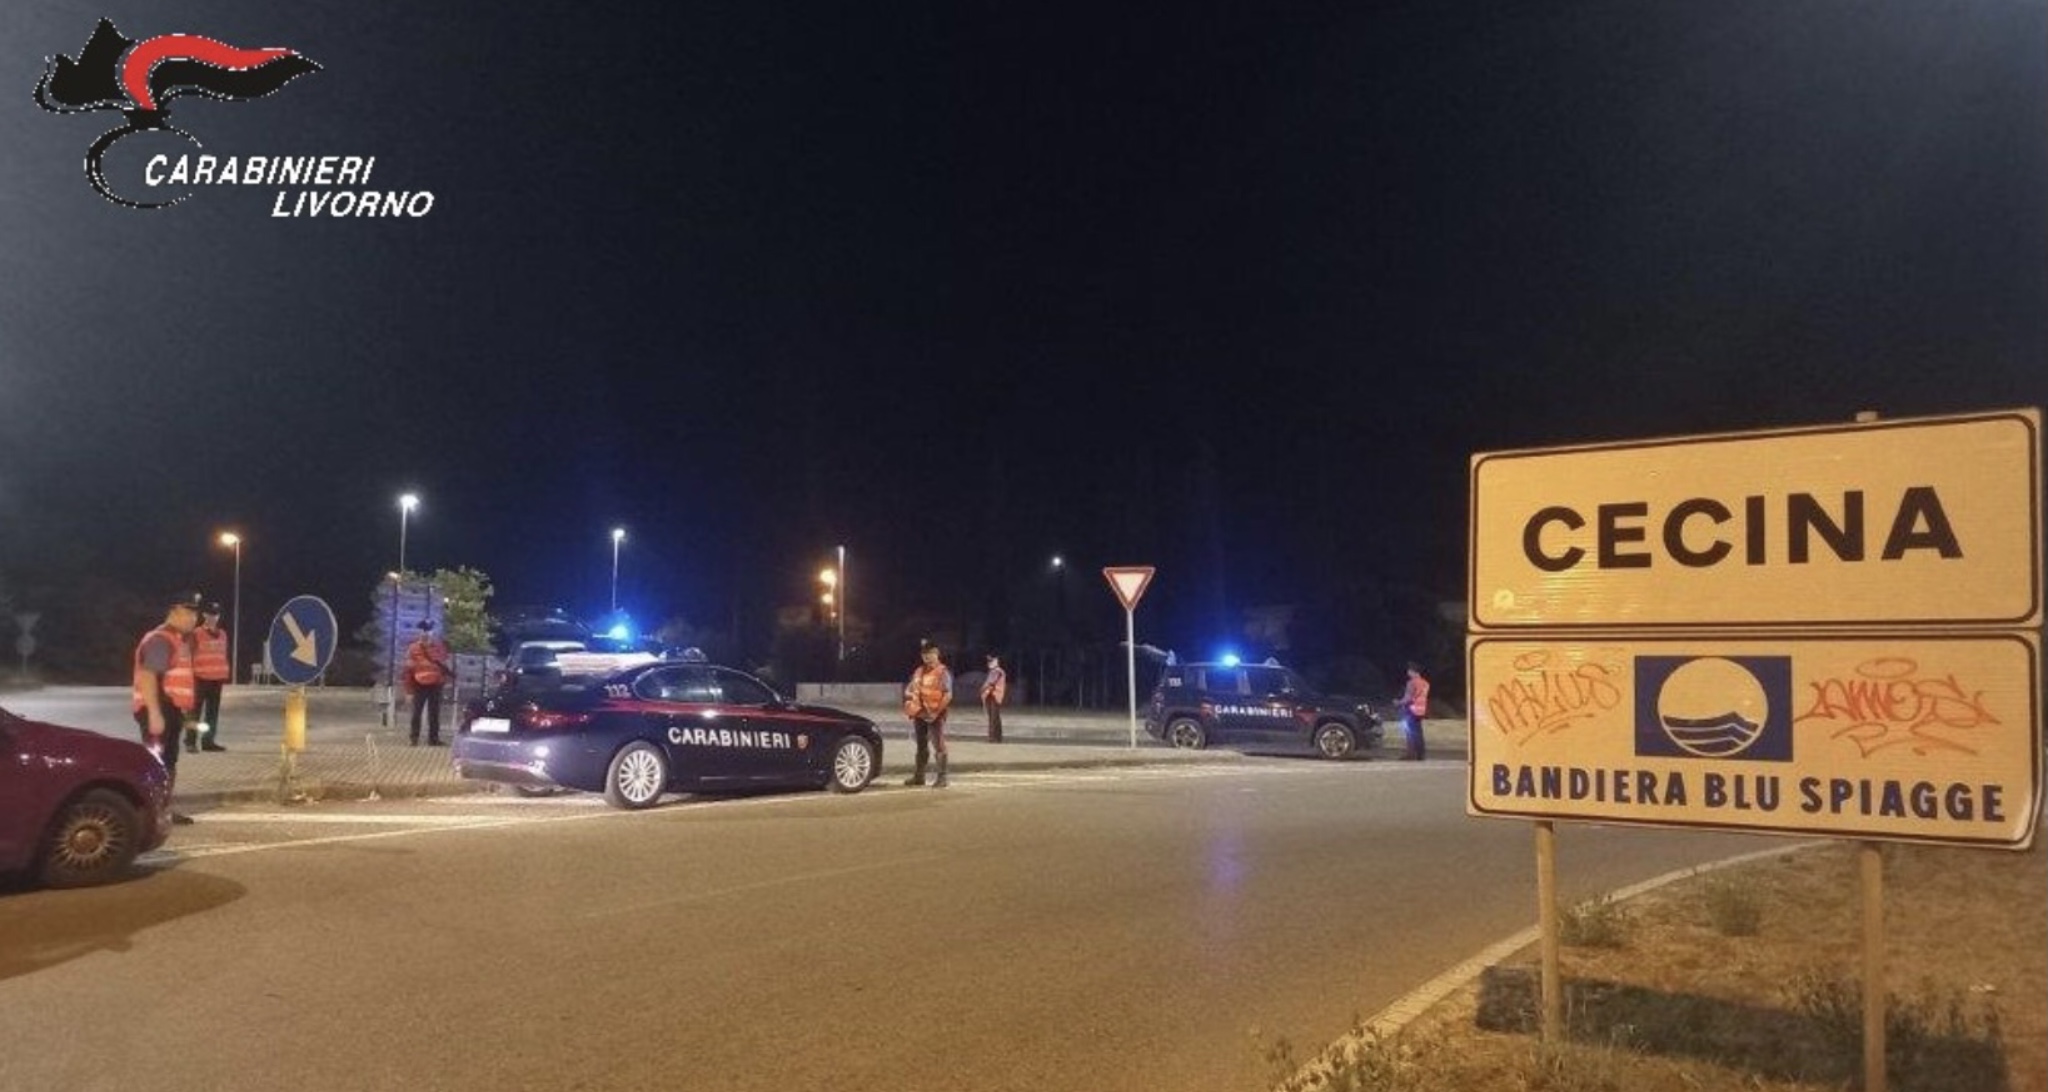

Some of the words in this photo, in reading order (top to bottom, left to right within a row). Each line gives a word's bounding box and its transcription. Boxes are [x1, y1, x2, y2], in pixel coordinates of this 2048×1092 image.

[1522, 486, 1963, 572] CECINA
[1214, 704, 1294, 719] CARABINIERI
[667, 727, 791, 749] CARABINIERI
[1492, 764, 1687, 806] BANDIERA
[1704, 772, 1779, 812] BLU
[1799, 776, 2006, 823] SPIAGGE
